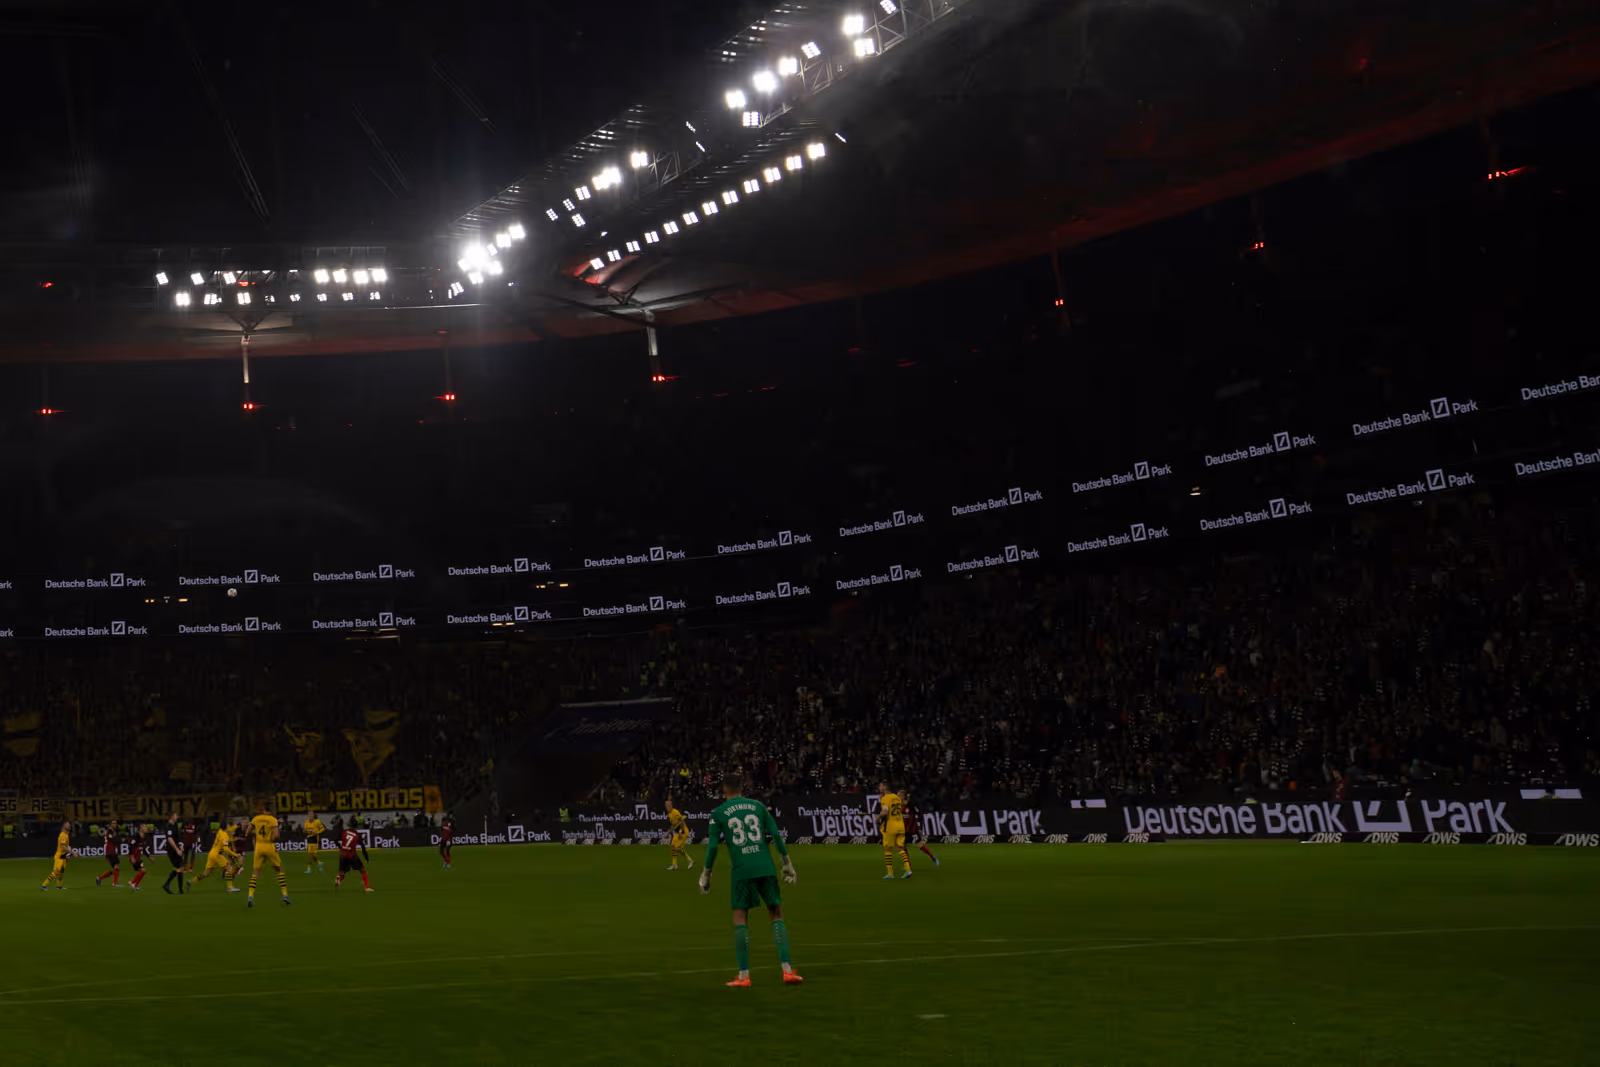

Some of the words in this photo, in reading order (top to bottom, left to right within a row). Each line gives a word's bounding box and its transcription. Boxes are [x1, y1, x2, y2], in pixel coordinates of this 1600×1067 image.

[1520, 379, 1579, 401] Deutsche
[1352, 416, 1402, 436] Deutsche
[1402, 409, 1431, 426] Bank
[1451, 399, 1479, 415] Park
[1204, 449, 1249, 467] Deutsche
[1248, 442, 1275, 457] Bank
[1292, 434, 1316, 448] Park
[1514, 455, 1573, 475] Deutsche
[1072, 477, 1112, 493] Deutsche
[1111, 471, 1135, 485] Bank
[1151, 463, 1173, 477] Park
[951, 501, 988, 516] Deutsche
[987, 496, 1009, 509] Bank
[1023, 489, 1043, 503] Park
[839, 523, 874, 537] Deutsche
[873, 518, 893, 531] Bank
[906, 512, 925, 525] Park
[717, 541, 757, 554] Deutsche
[756, 538, 779, 549] Bank
[793, 533, 812, 544] Park
[1067, 537, 1108, 553] Deutsche
[1107, 532, 1131, 546] Bank
[1147, 526, 1169, 540] Park
[312, 571, 354, 582] Deutsche
[354, 570, 378, 580] Bank
[395, 569, 415, 578] Park
[448, 565, 489, 576] Deutsche
[490, 564, 513, 574] Bank
[530, 561, 551, 572] Park
[45, 579, 86, 589] Deutsche
[86, 578, 109, 588] Bank
[126, 577, 146, 587] Park
[715, 592, 755, 605] Deutsche
[755, 589, 777, 601] Bank
[792, 585, 811, 596] Park
[70, 799, 110, 816] THE
[724, 803, 756, 816] DORTMUND
[993, 809, 1045, 834] Park
[1122, 804, 1257, 834] Deutsche
[1262, 800, 1348, 833] Bank
[1421, 799, 1515, 833] Park
[258, 825, 266, 837] 4
[728, 814, 762, 846] 33
[345, 835, 355, 847] 7
[374, 835, 400, 848] Park
[480, 832, 506, 844] Bank
[527, 831, 551, 842] Park
[1087, 833, 1107, 843] DWS
[1128, 833, 1149, 843] DWS
[1316, 833, 1343, 843] DWS
[1371, 832, 1399, 844] DWS
[1431, 832, 1461, 845] DWS
[1495, 833, 1527, 846] DWS
[1565, 834, 1600, 847] DWS
[742, 845, 760, 854] MEYER
